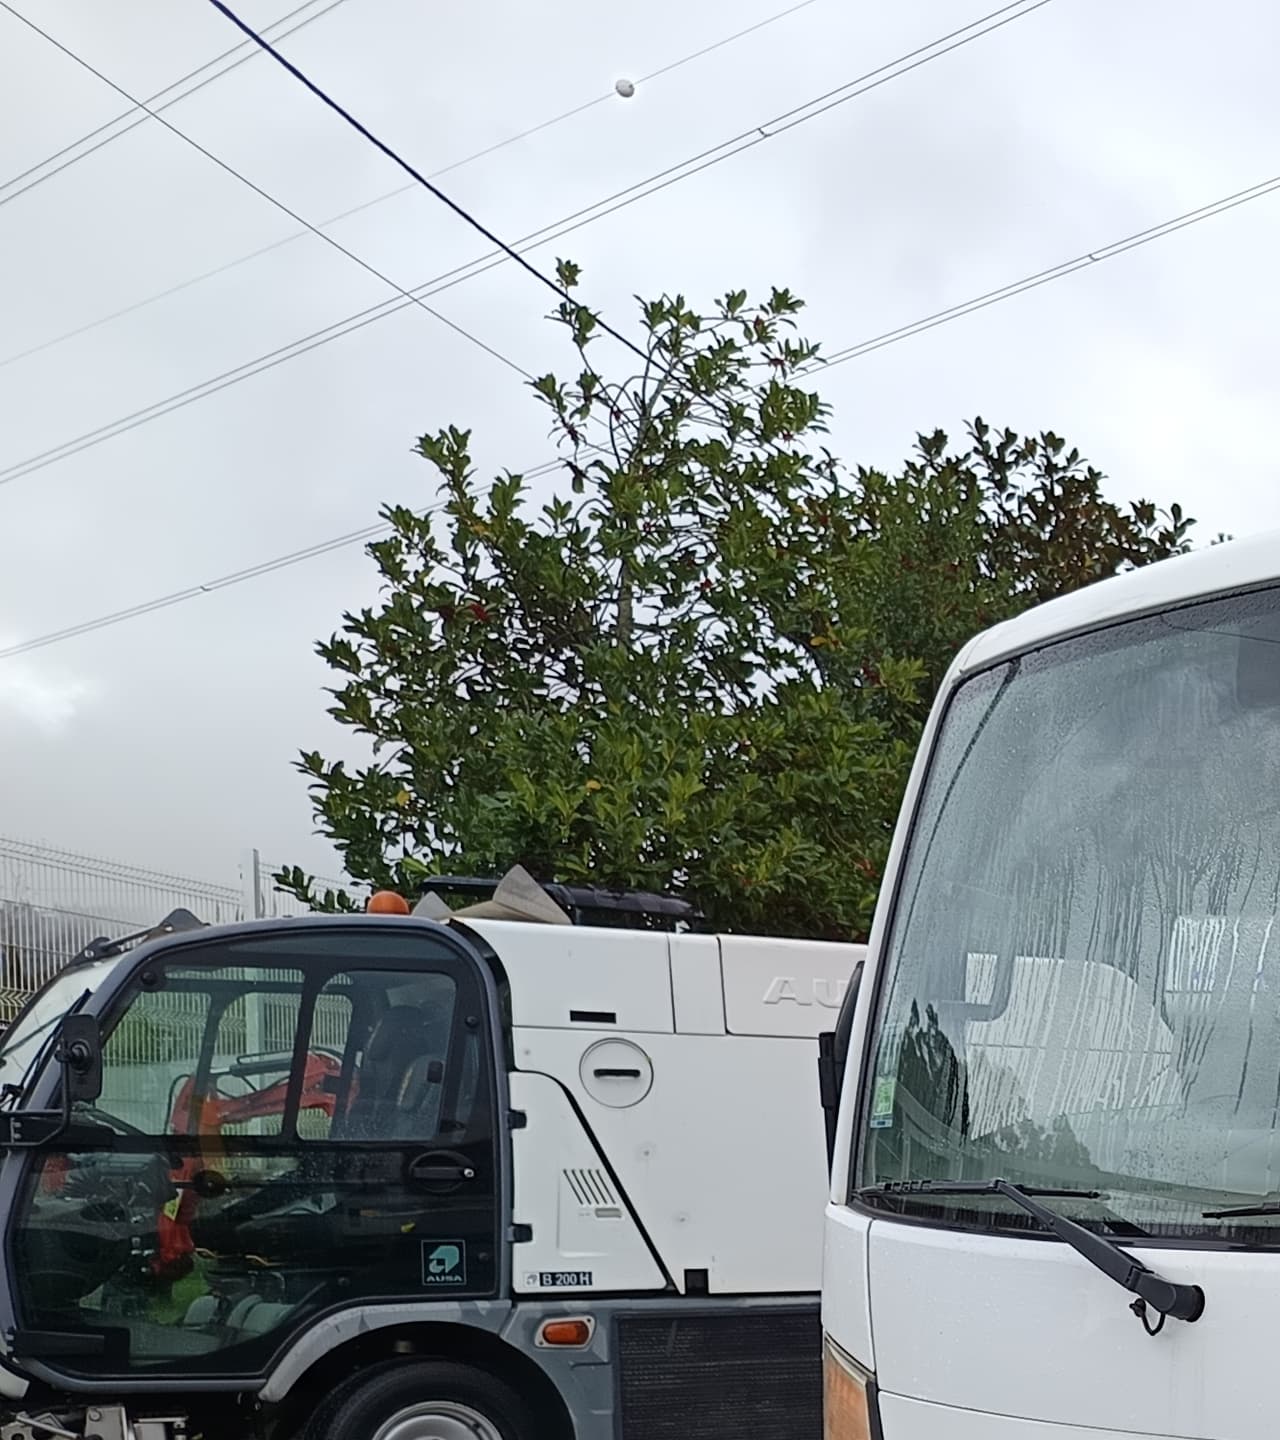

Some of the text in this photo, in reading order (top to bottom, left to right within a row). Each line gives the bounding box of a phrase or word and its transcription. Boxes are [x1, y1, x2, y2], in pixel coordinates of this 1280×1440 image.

[426, 1275, 463, 1283] AUSA
[542, 1273, 590, 1286] B 200 H
